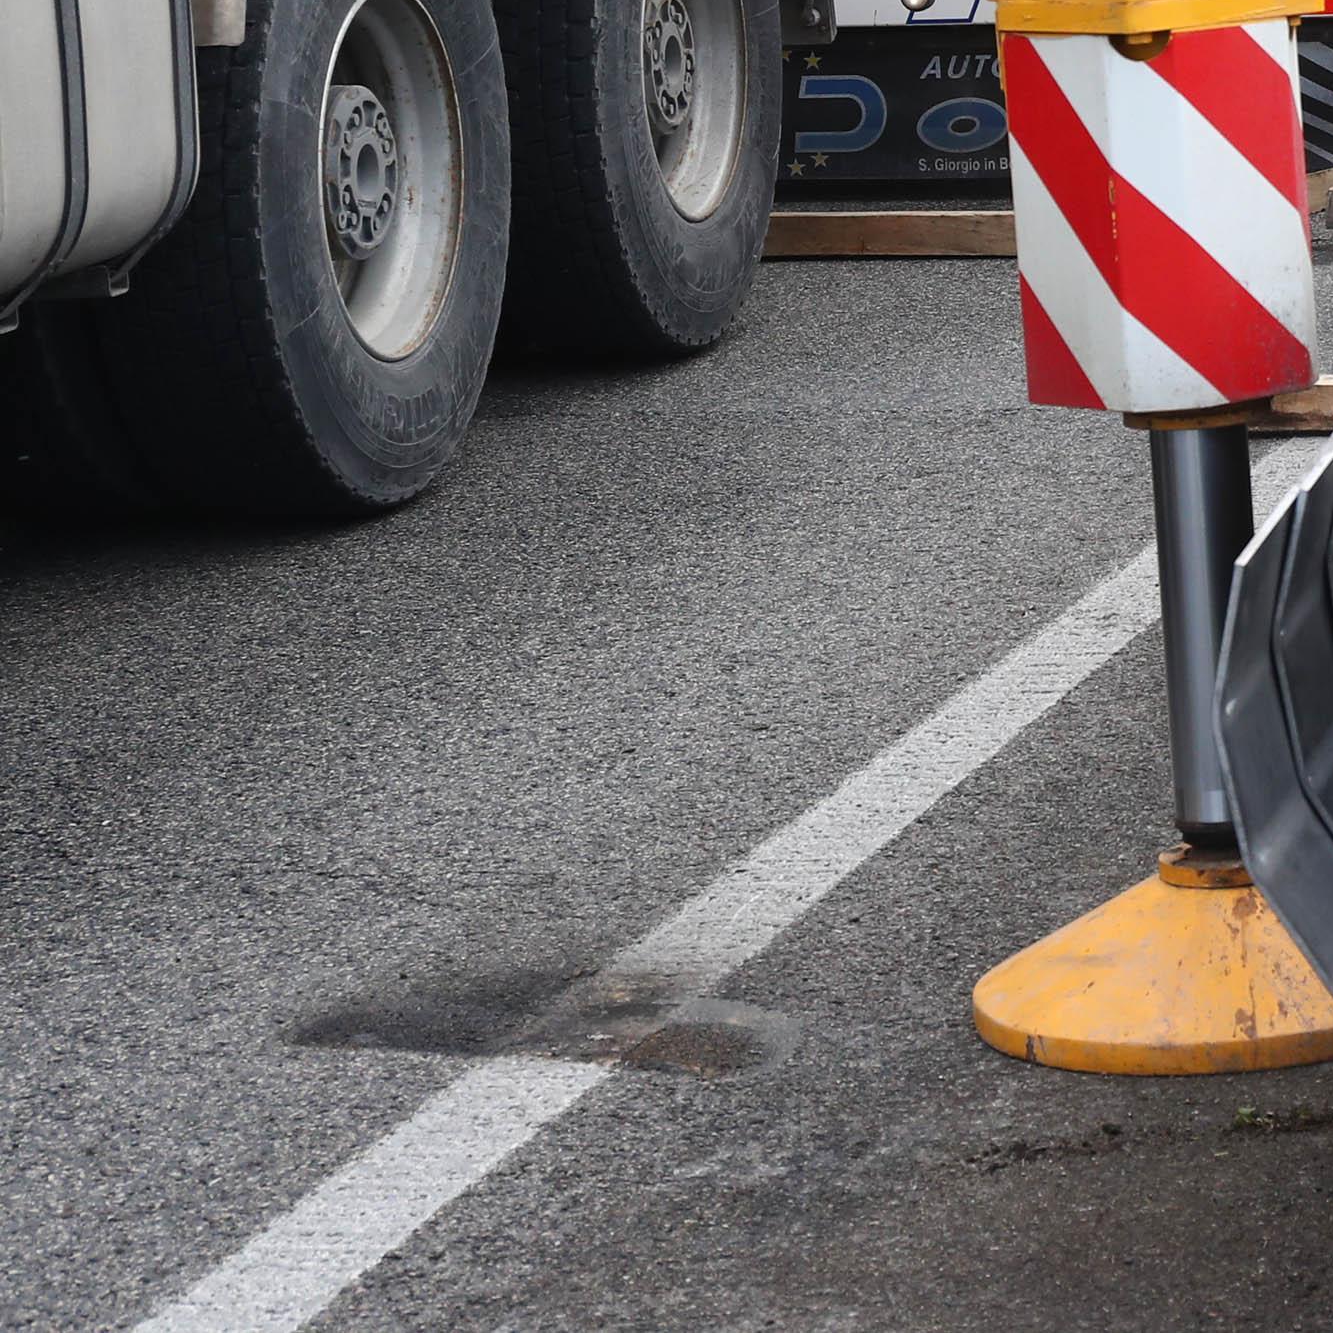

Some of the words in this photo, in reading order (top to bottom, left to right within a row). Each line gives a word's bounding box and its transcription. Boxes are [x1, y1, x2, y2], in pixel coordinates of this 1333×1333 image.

[917, 157, 931, 172] S.
[934, 157, 981, 174] Giorgio
[983, 157, 996, 171] in
